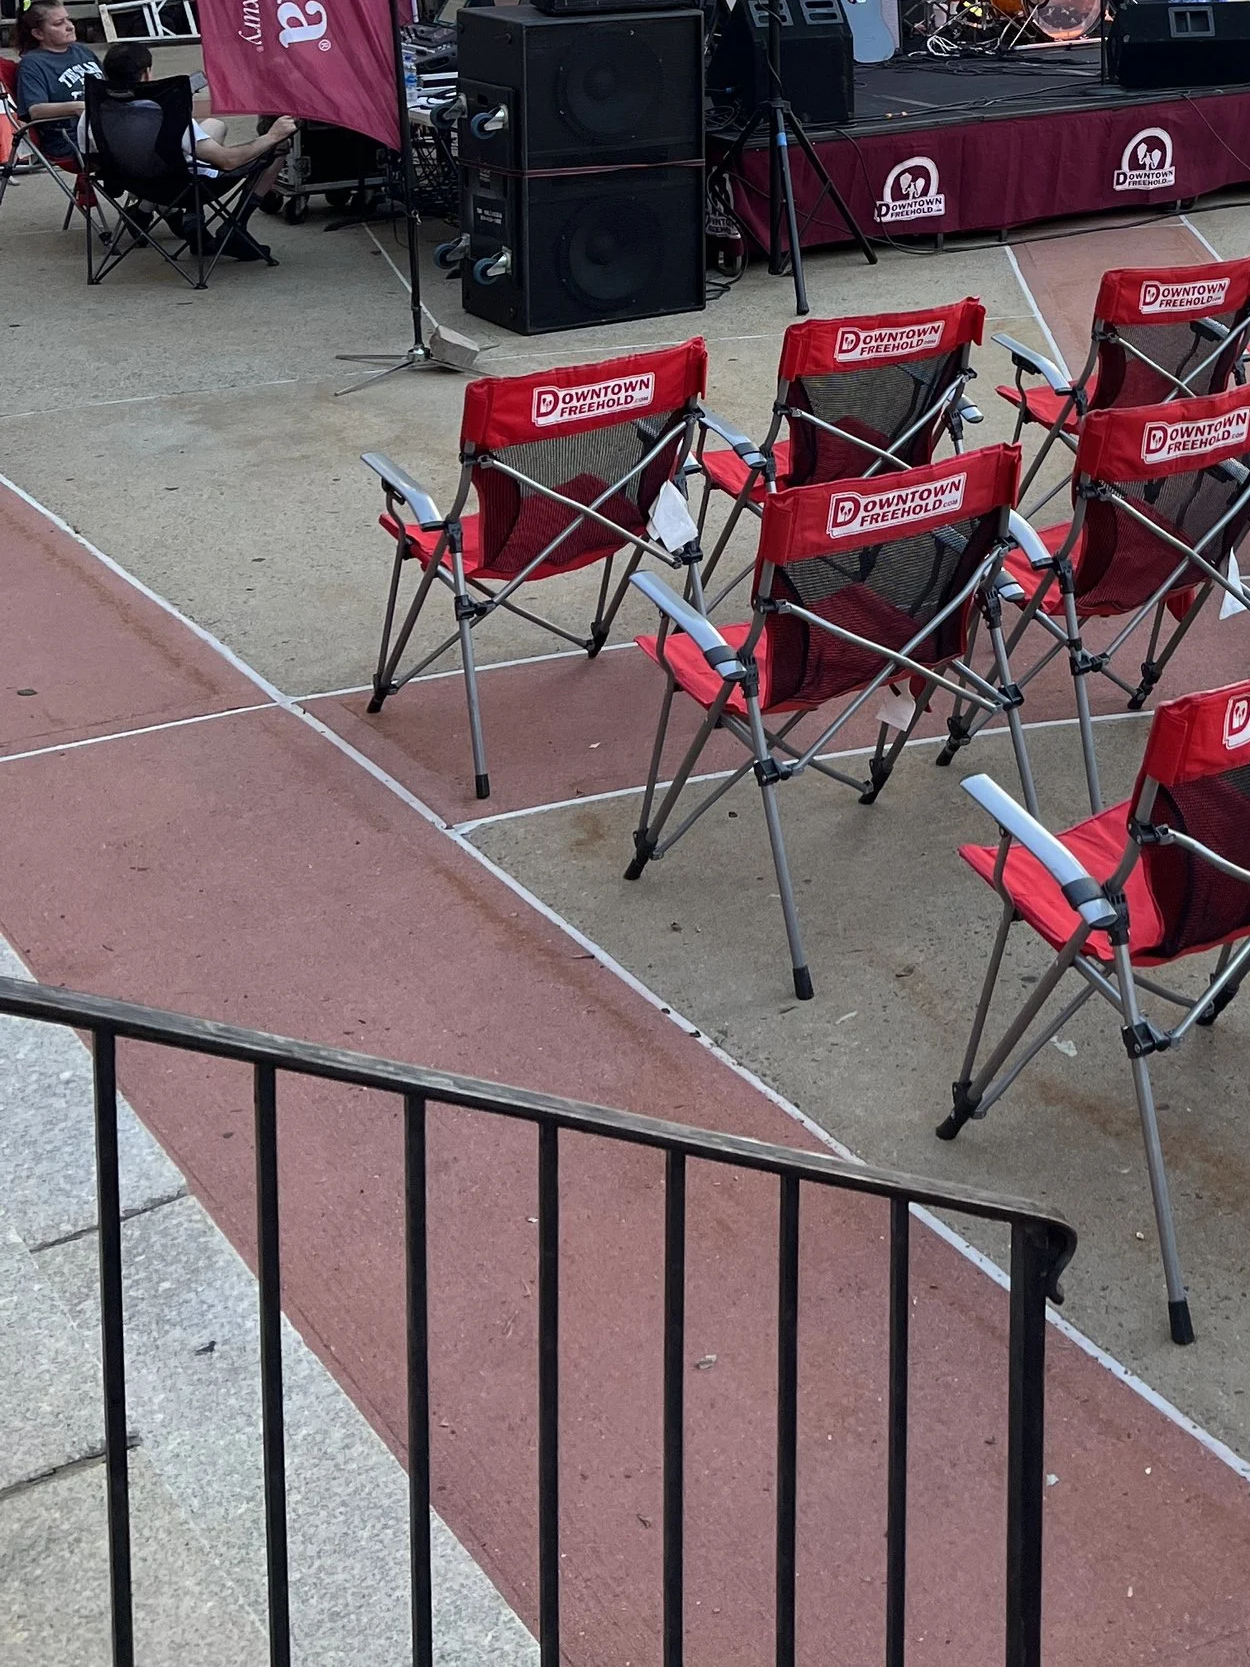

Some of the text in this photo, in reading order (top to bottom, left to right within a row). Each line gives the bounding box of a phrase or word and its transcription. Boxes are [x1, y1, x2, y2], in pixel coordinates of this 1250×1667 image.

[1115, 170, 1174, 186] DOWNTOWN
[879, 197, 942, 218] DOWNTOWN
[1142, 282, 1227, 307] DOWNTOWN
[841, 324, 940, 351] DOWNTOWN
[539, 376, 652, 420] DOWNTOWN
[1145, 413, 1247, 455] DOWNTOWN
[831, 480, 962, 530] DOWNTOWN
